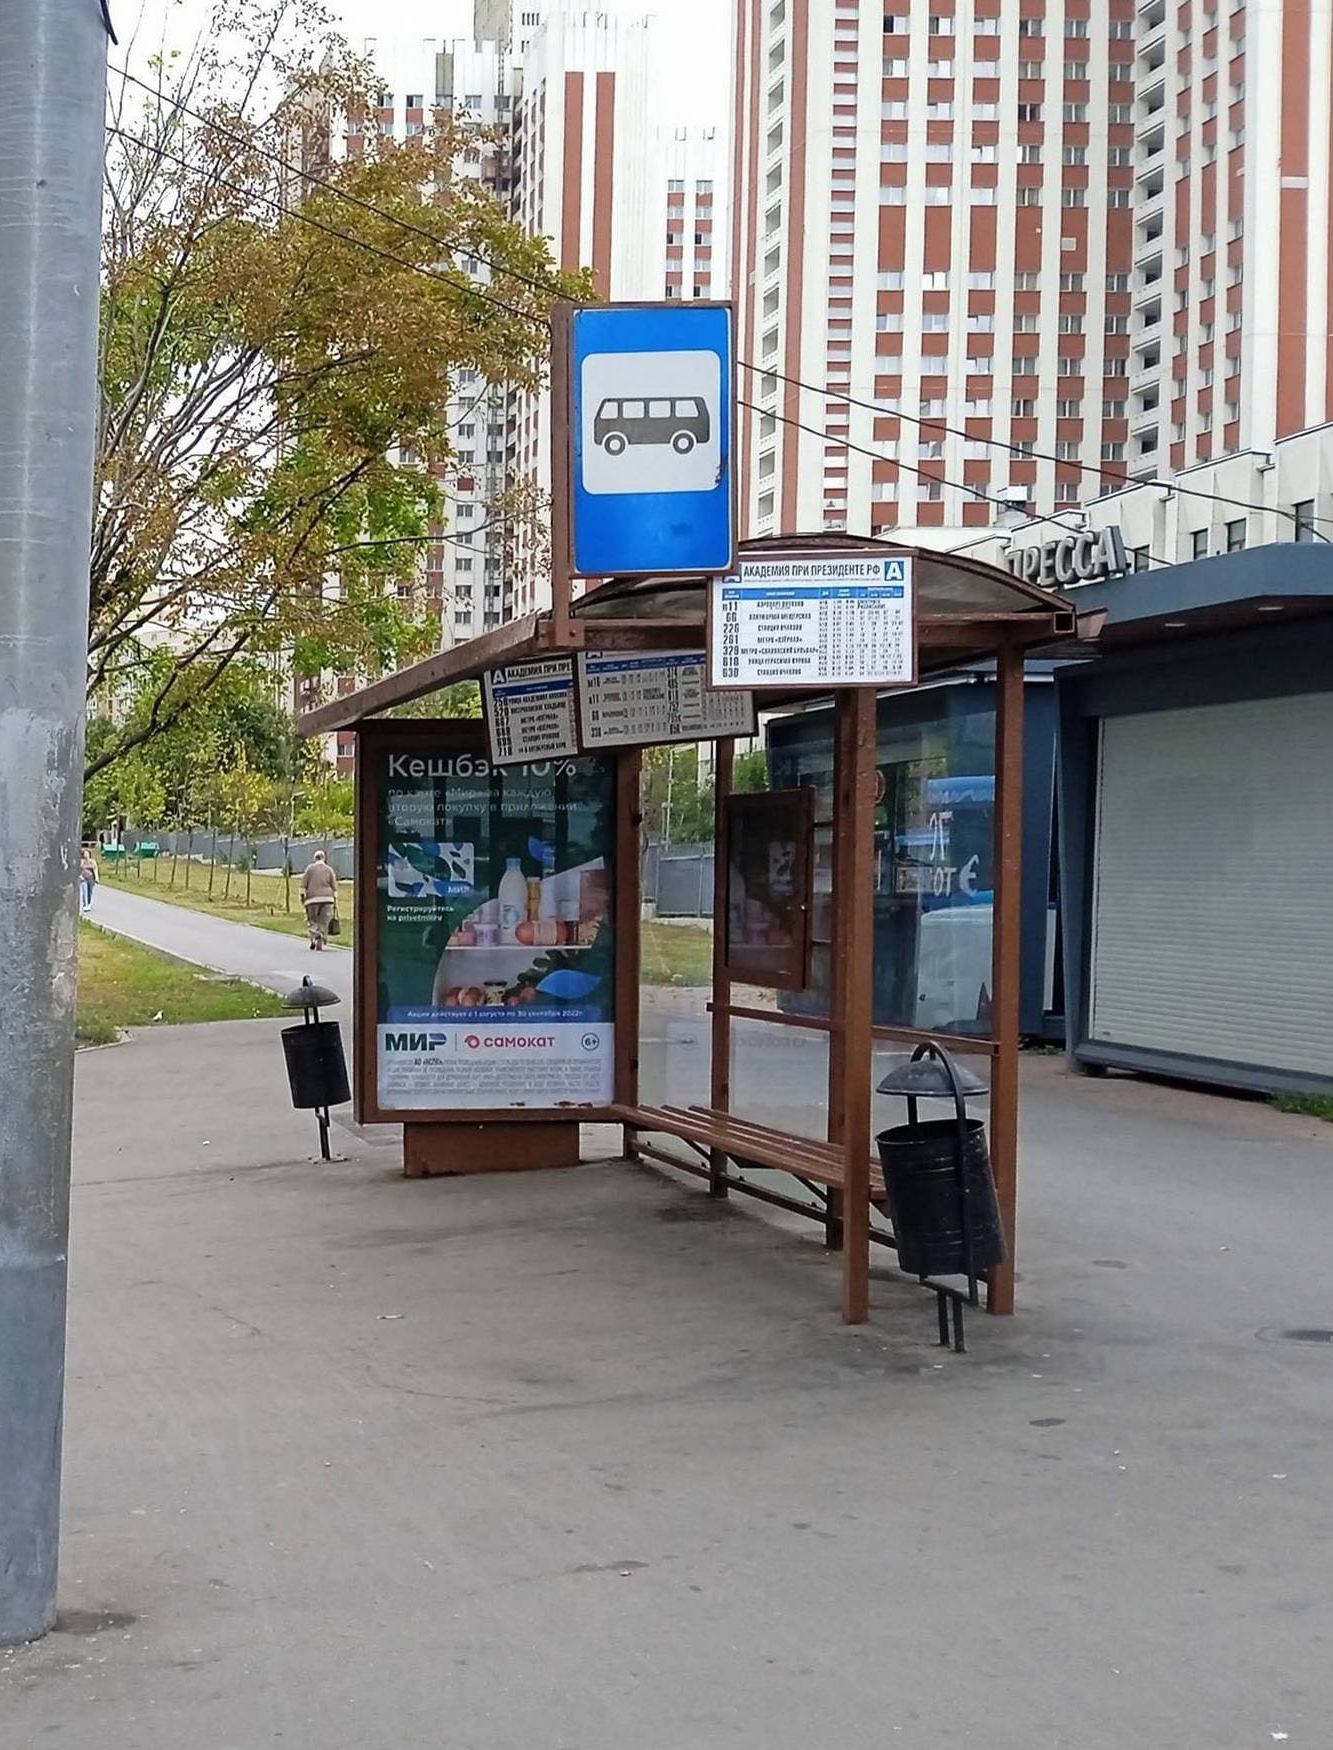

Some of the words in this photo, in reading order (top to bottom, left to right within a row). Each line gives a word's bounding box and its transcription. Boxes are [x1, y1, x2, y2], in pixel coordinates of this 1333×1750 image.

[1006, 525, 1123, 587] ПРЕССА
[744, 564, 790, 578] АКАДЕМИЯ
[792, 563, 809, 576] ПРИ
[811, 562, 865, 577] ПРЕЗИДЕНТЕ
[866, 562, 881, 575] РФ
[508, 666, 542, 678] АКАДЕМИЯ
[388, 754, 507, 777] Кешбэк
[385, 1032, 447, 1051] МИР
[484, 1037, 555, 1047] самокат
